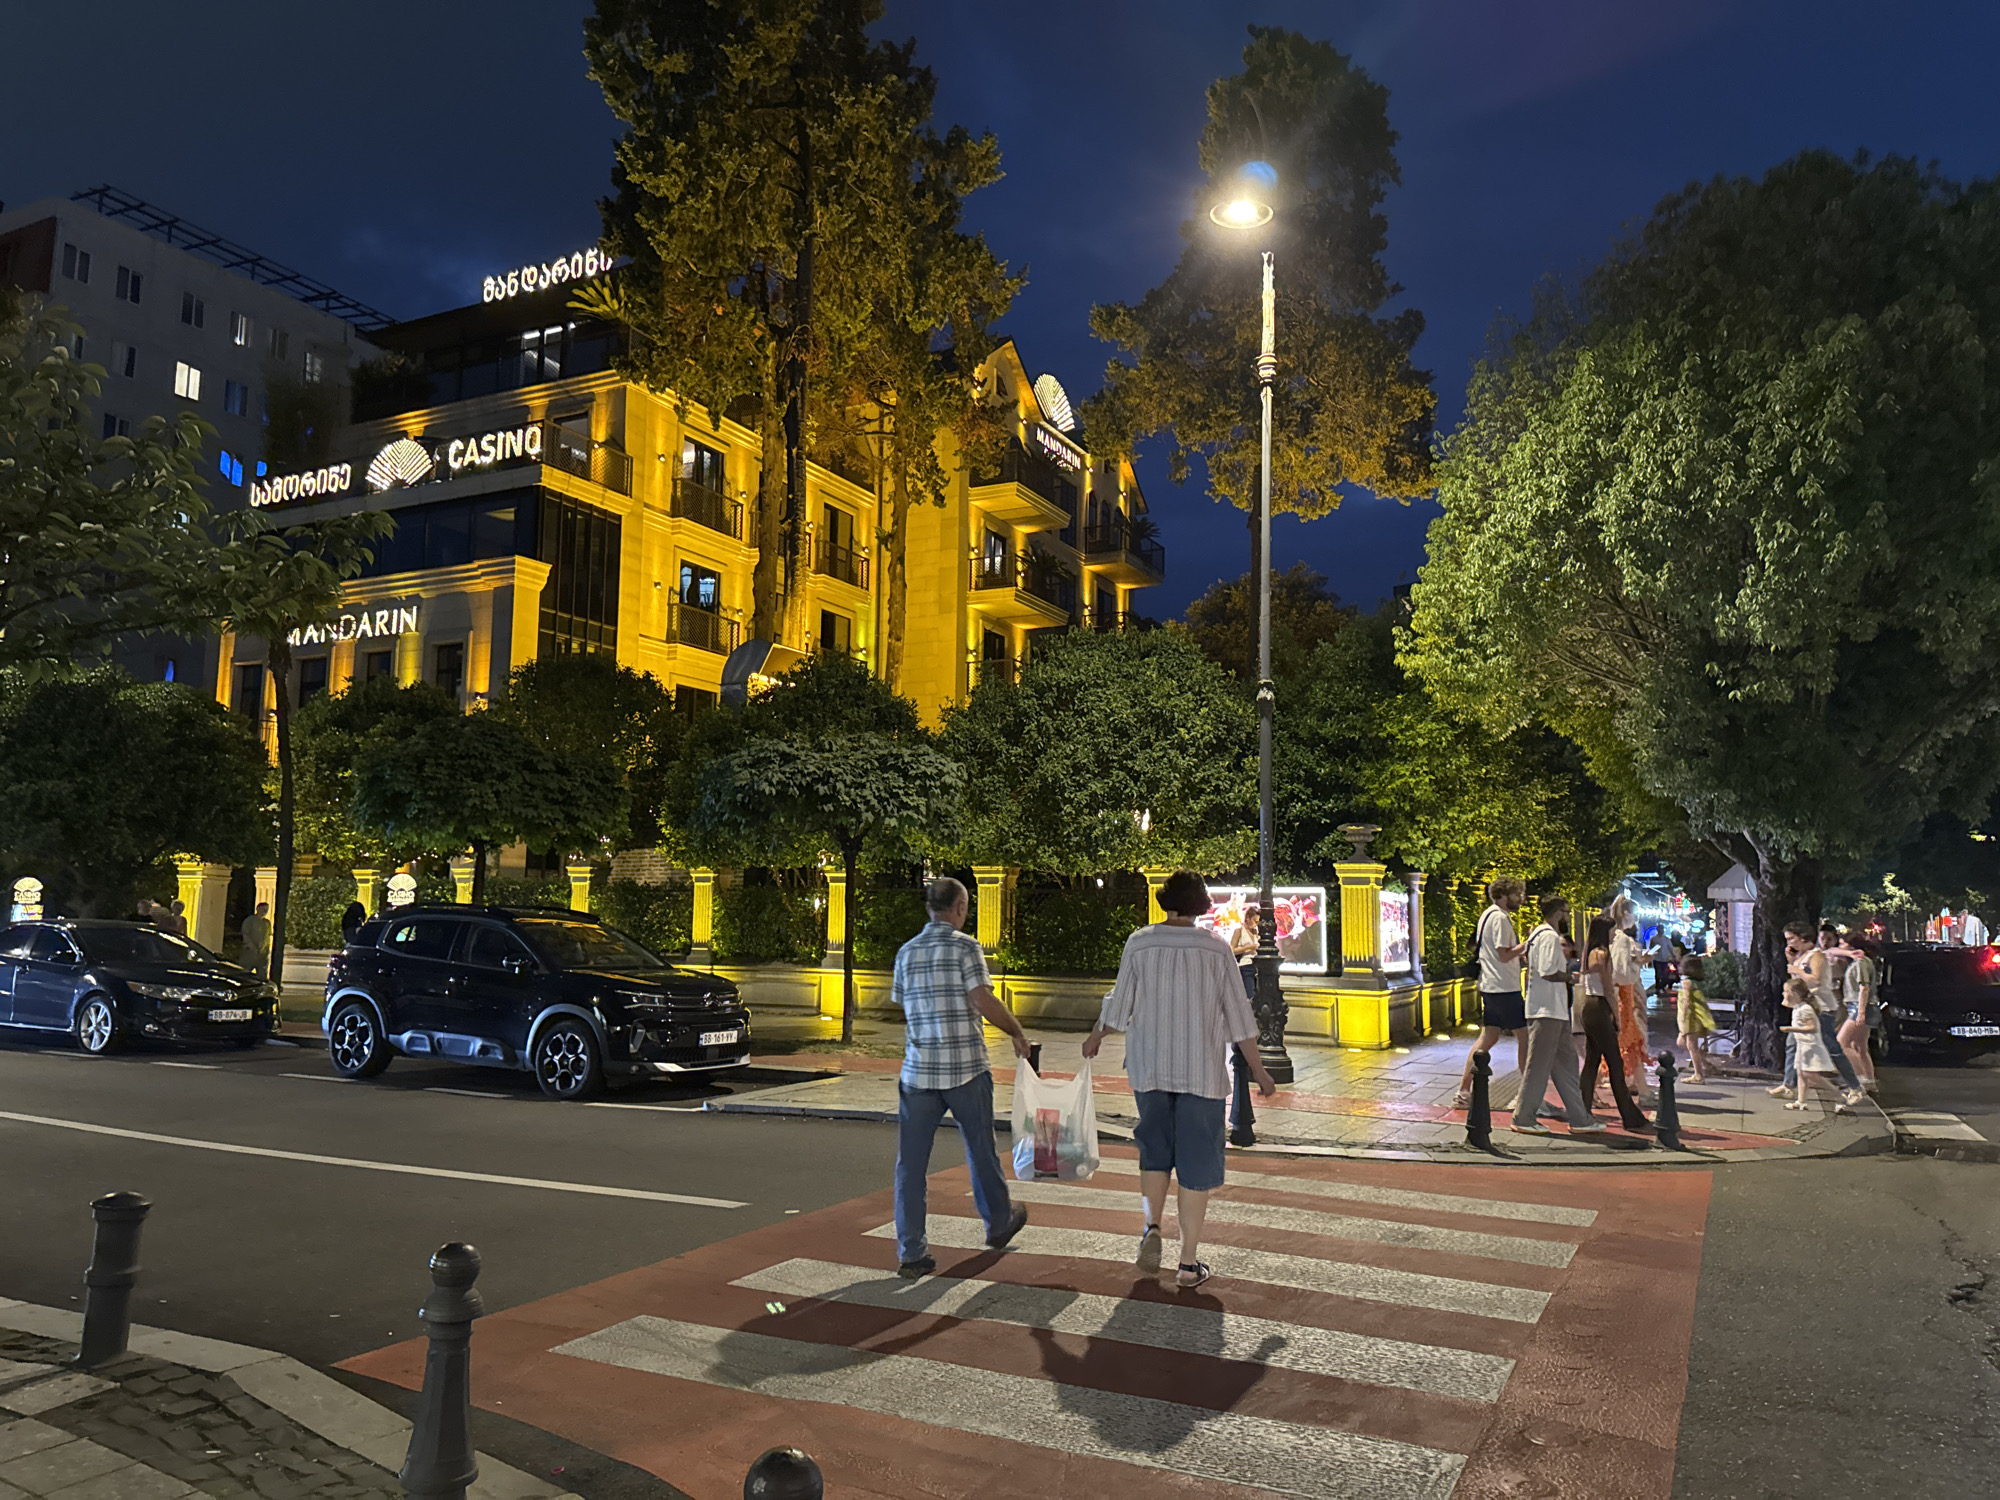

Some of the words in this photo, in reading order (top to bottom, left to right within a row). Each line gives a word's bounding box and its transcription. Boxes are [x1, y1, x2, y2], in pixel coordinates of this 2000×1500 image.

[449, 426, 541, 469] CASINO
[1036, 427, 1081, 470] MANDARIN
[250, 463, 352, 507] სამორინე
[14, 891, 41, 899] CASINO
[387, 890, 415, 898] CASINO
